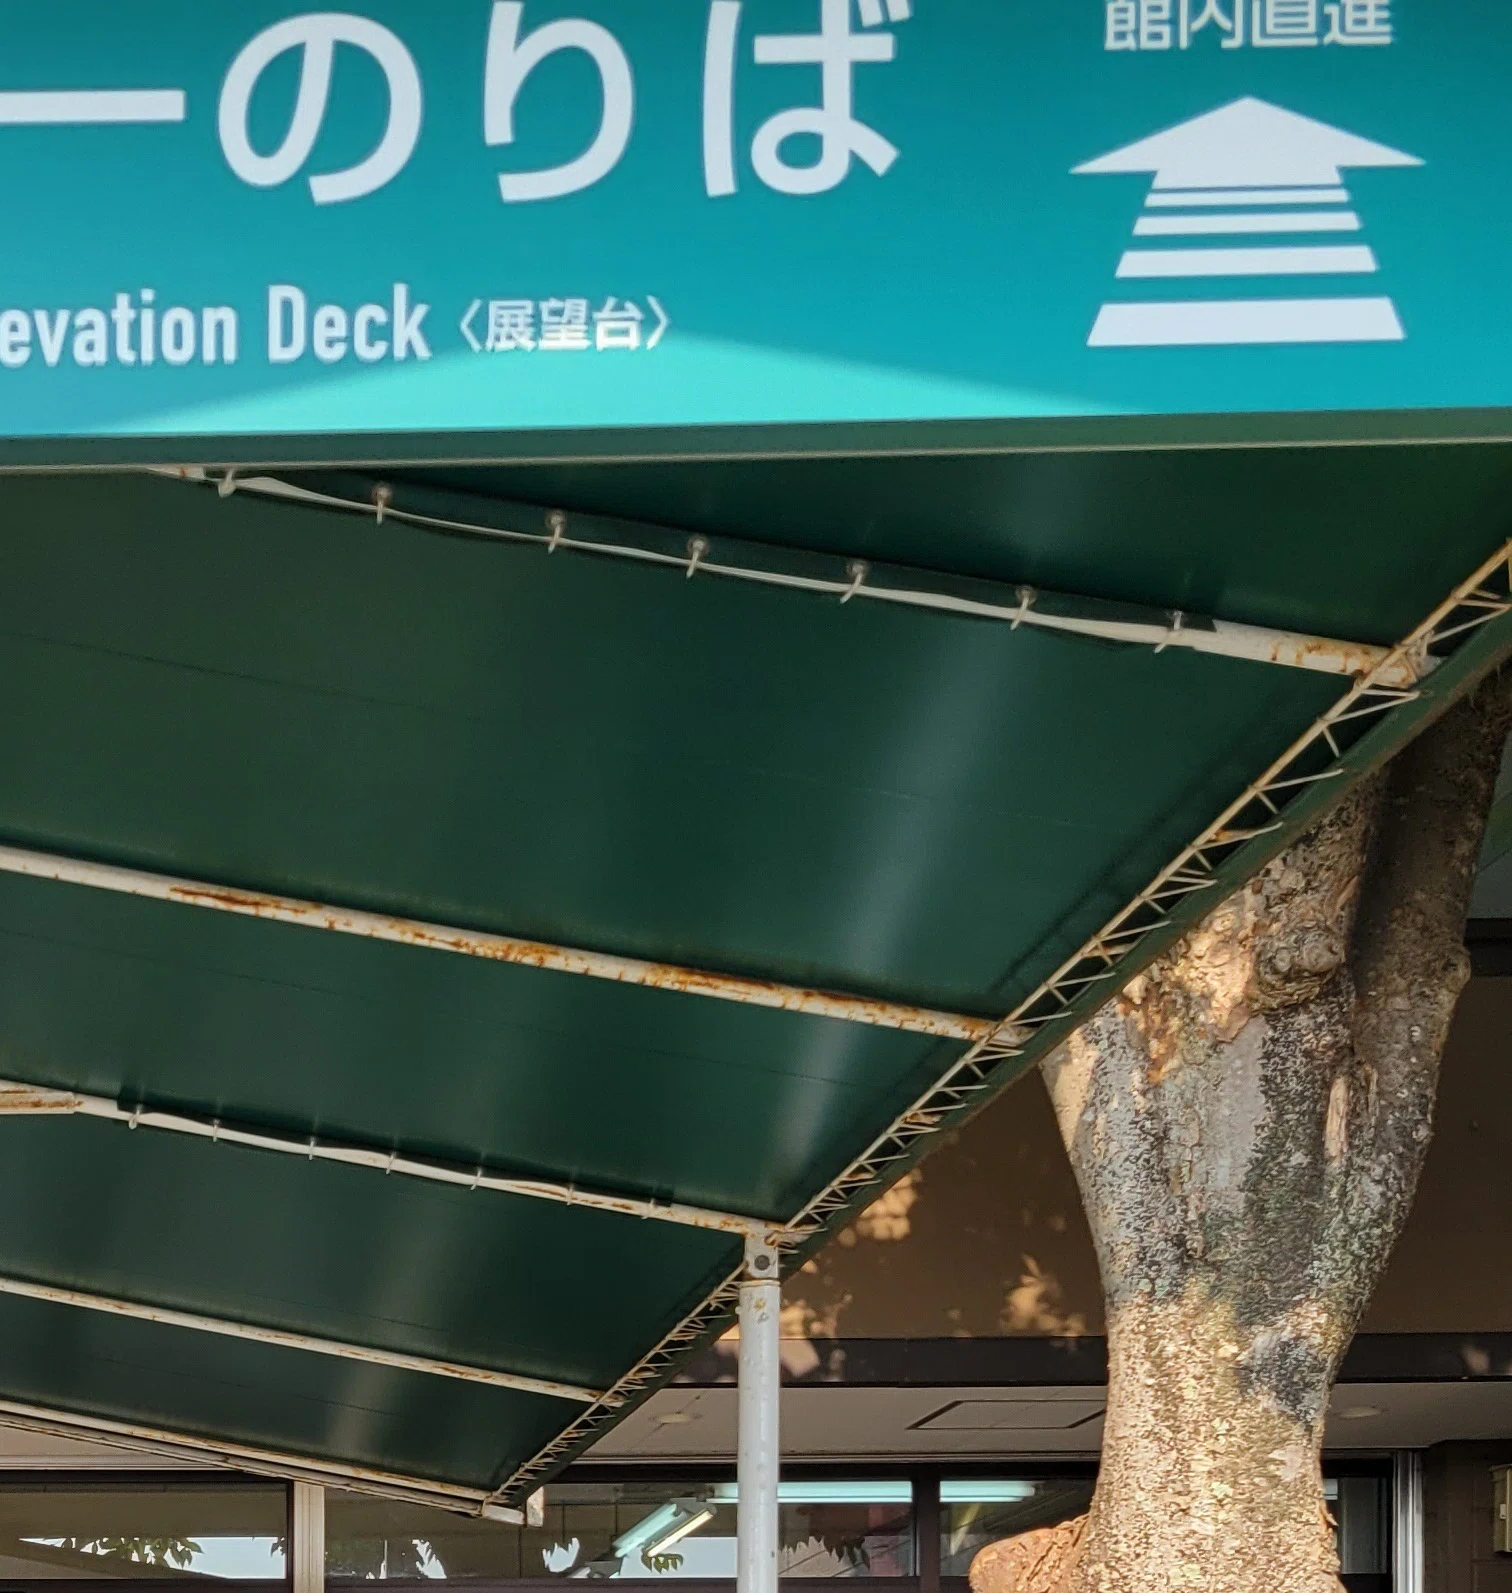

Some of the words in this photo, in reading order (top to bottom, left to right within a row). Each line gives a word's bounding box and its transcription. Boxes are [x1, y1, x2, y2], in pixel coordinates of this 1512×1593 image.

[1104, 0, 1392, 50] 館内直進
[268, 284, 431, 362] Deck
